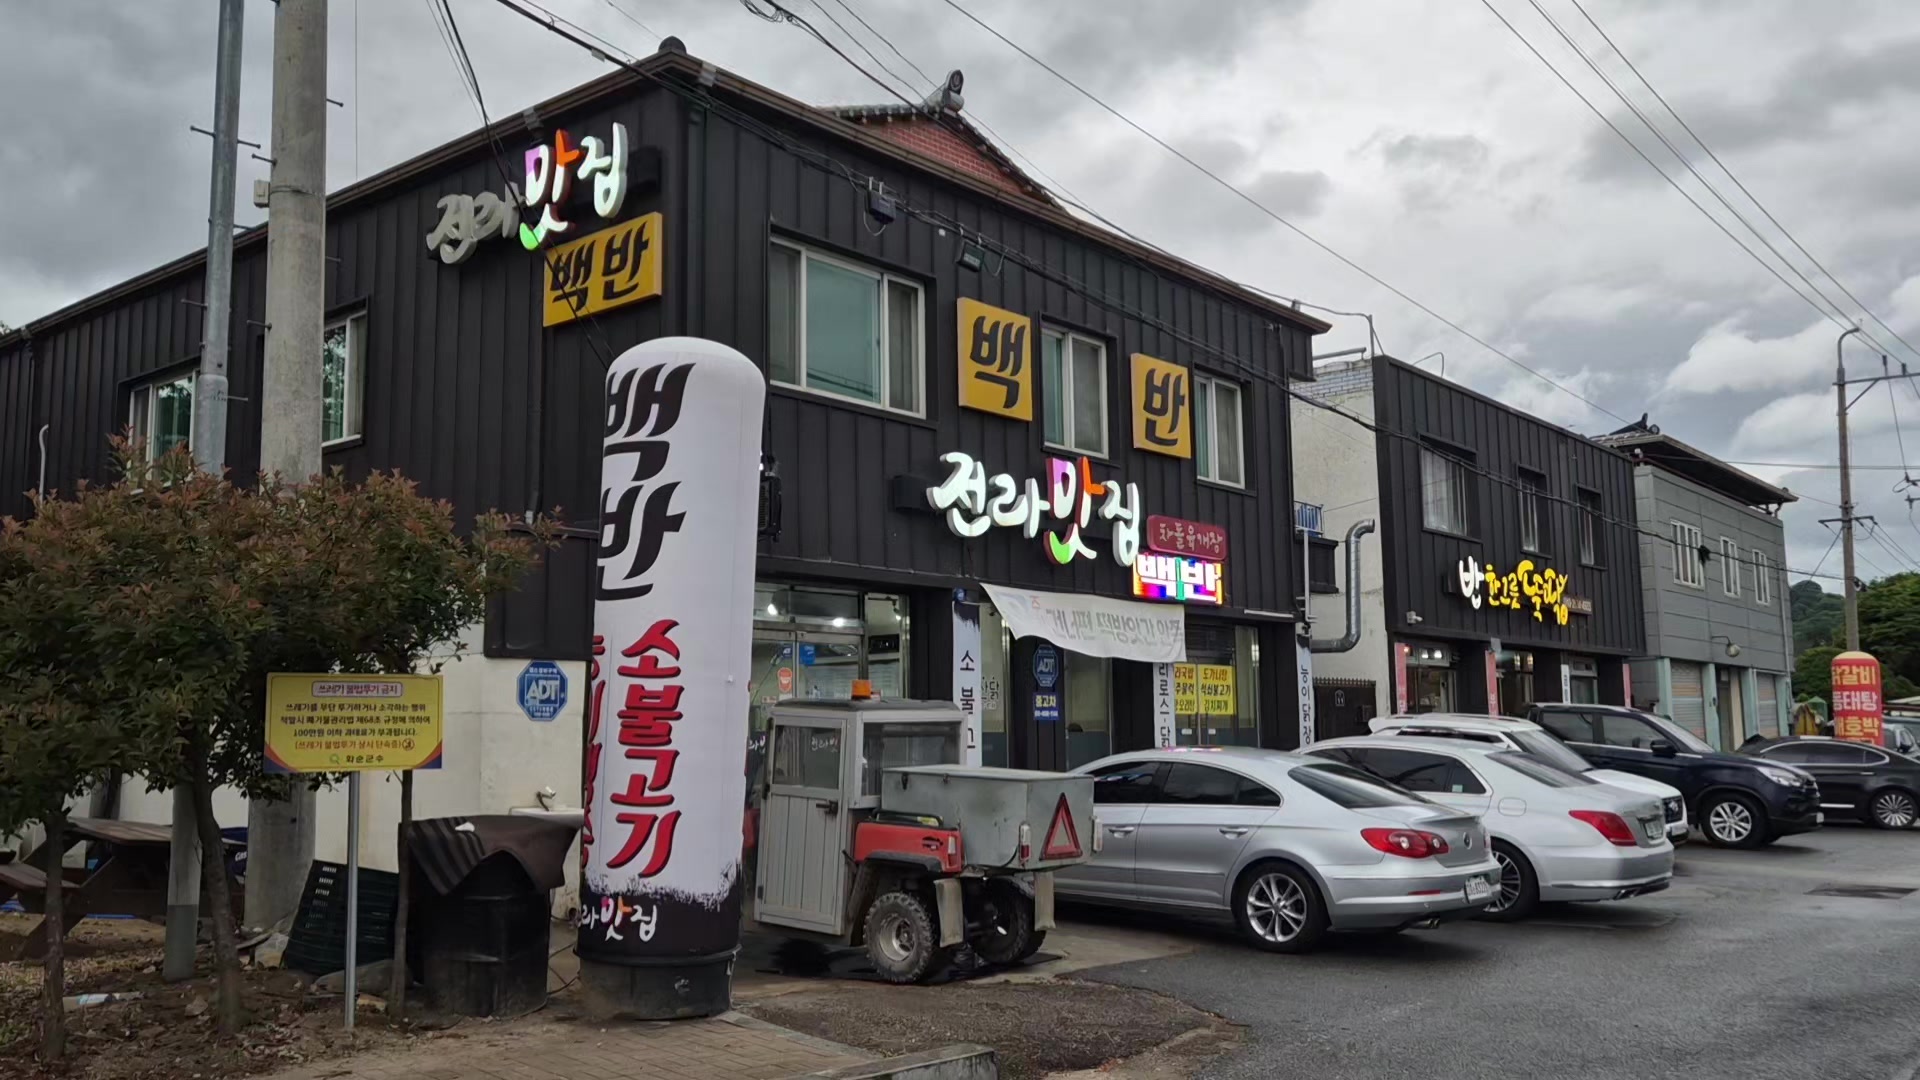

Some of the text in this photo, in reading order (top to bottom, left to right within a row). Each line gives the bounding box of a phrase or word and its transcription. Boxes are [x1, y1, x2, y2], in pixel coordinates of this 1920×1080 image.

[550, 221, 650, 313] 백반
[970, 315, 1186, 447] 백 반
[926, 451, 1141, 568] 전라맛집
[1136, 552, 1222, 604] 백반
[1458, 555, 1485, 610] 밥
[317, 684, 345, 695] 쓰레기
[381, 685, 398, 696] 금지
[526, 679, 560, 701] ADT
[606, 618, 685, 878] 소불고기
[578, 896, 658, 943] 라맛집
